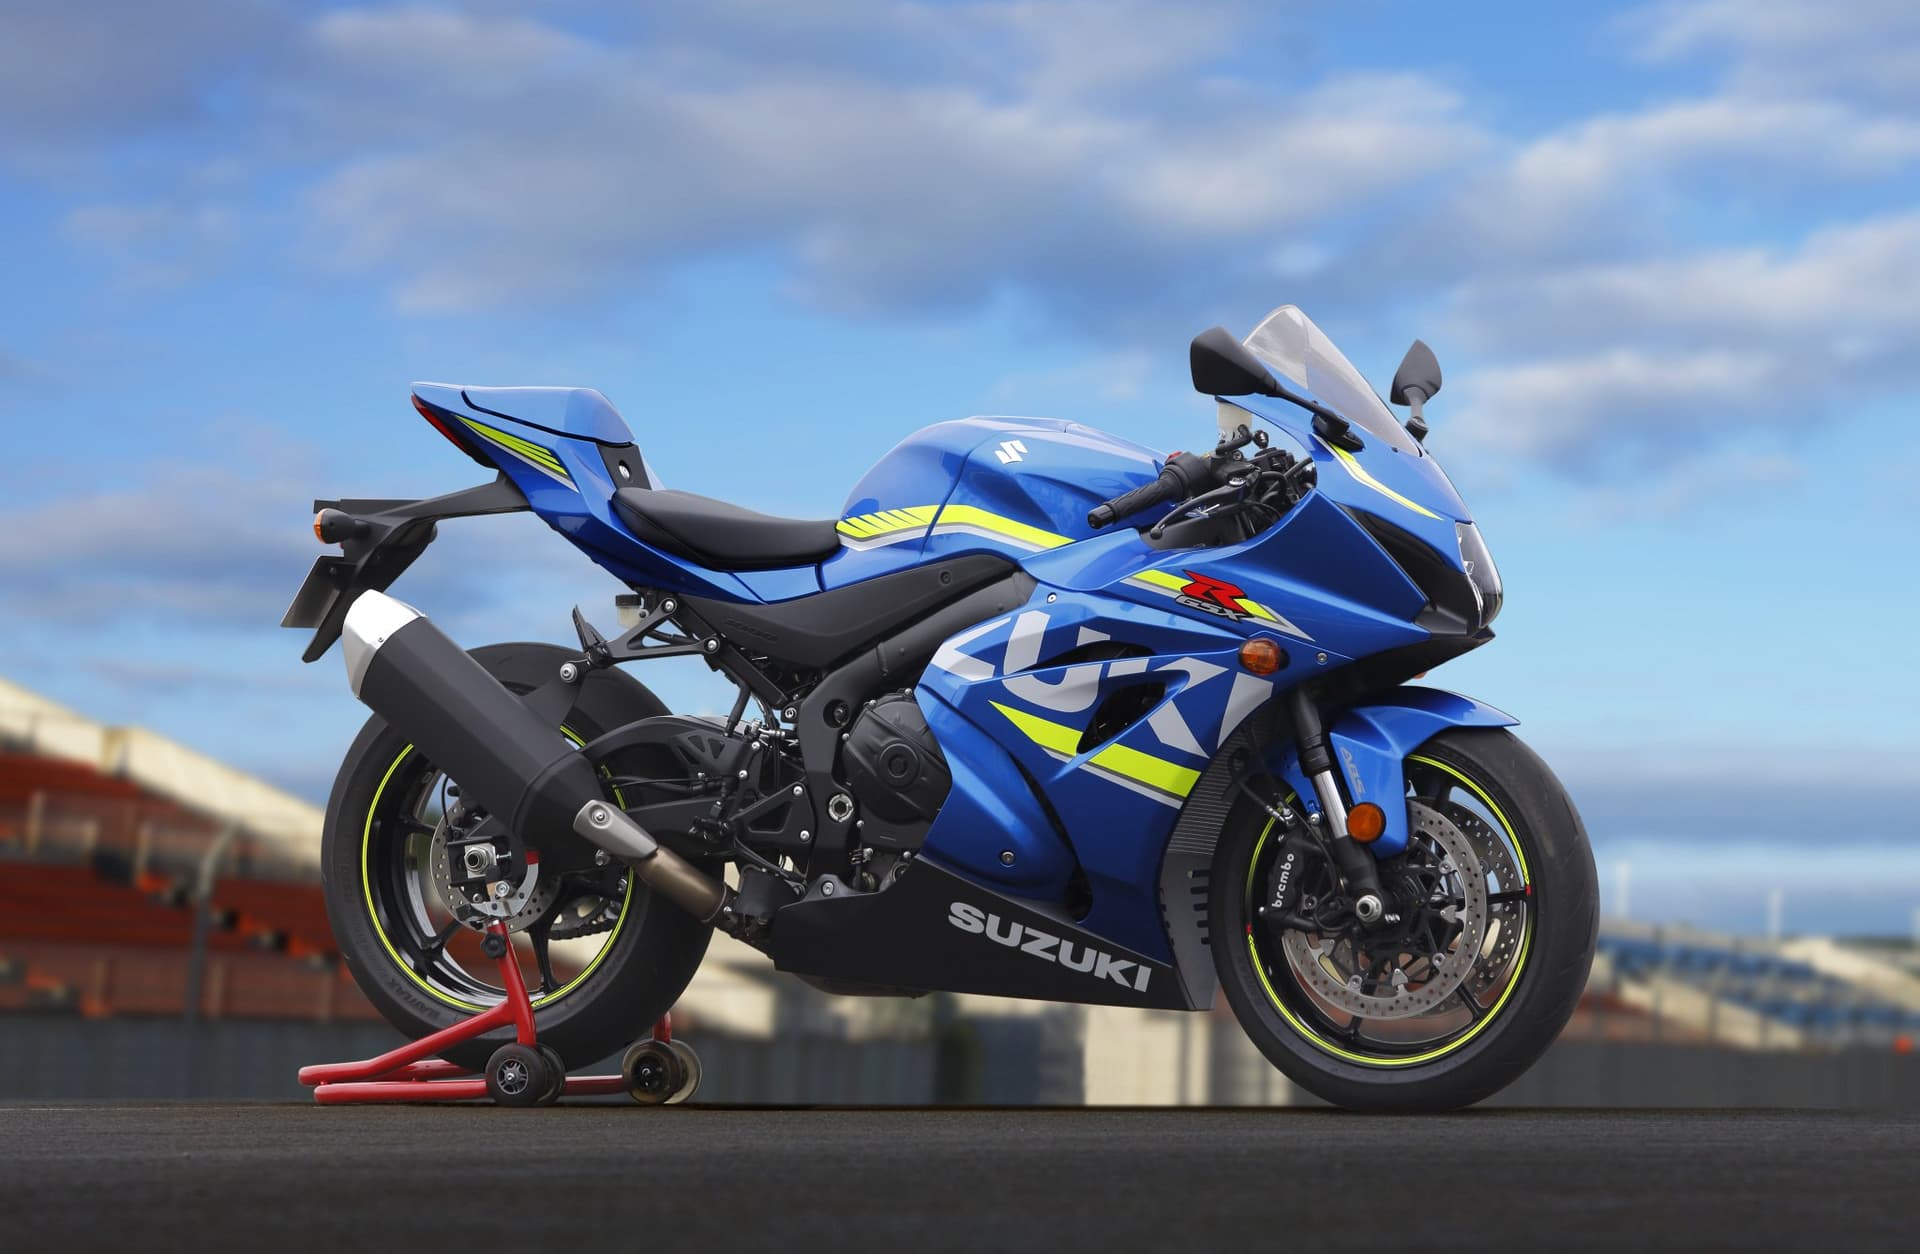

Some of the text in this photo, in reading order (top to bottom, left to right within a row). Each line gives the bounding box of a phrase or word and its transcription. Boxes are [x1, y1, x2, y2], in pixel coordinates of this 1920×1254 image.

[1175, 595, 1245, 622] GSX
[1271, 853, 1295, 908] brembo
[948, 902, 1152, 993] SUZUKI
